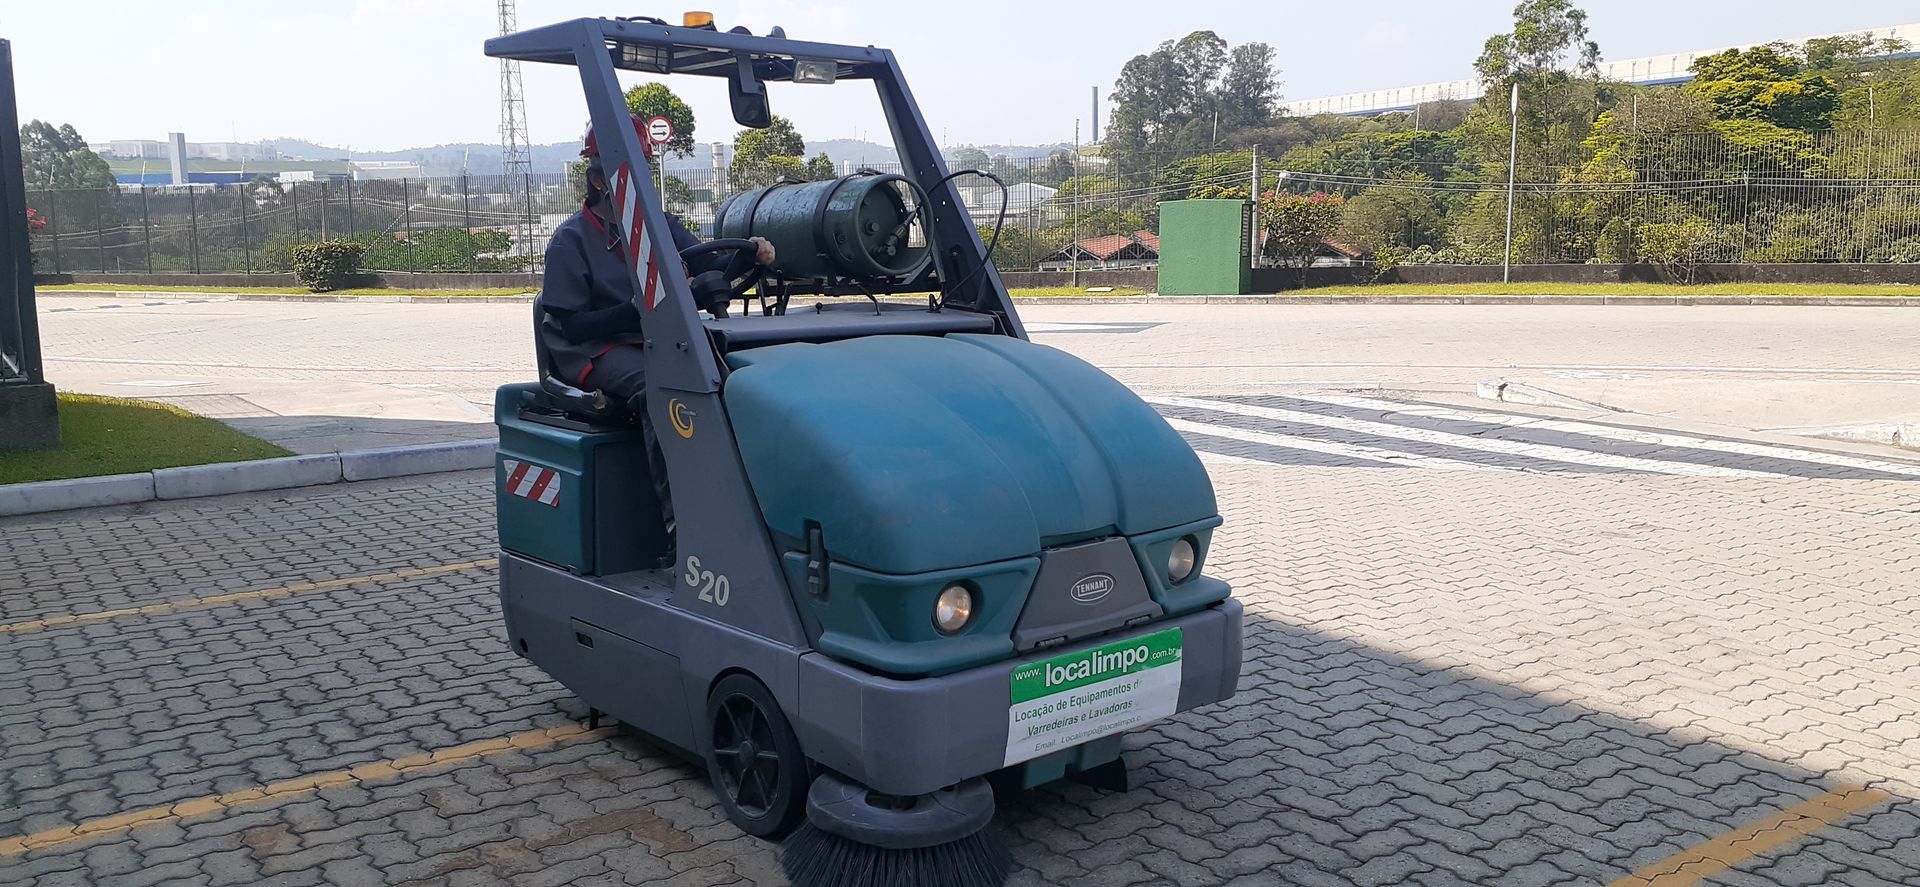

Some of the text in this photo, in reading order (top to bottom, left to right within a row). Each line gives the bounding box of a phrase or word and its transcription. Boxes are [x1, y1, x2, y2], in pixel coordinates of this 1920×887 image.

[684, 555, 730, 607] S20
[1076, 579, 1108, 597] TENNANT
[1015, 668, 1041, 681] www.
[1045, 645, 1149, 688] localimpo
[1015, 703, 1054, 723] Locação
[1056, 699, 1068, 711] de
[1070, 682, 1131, 705] Equipamentos
[1027, 700, 1133, 737] Varredeiras e Lavadoras
